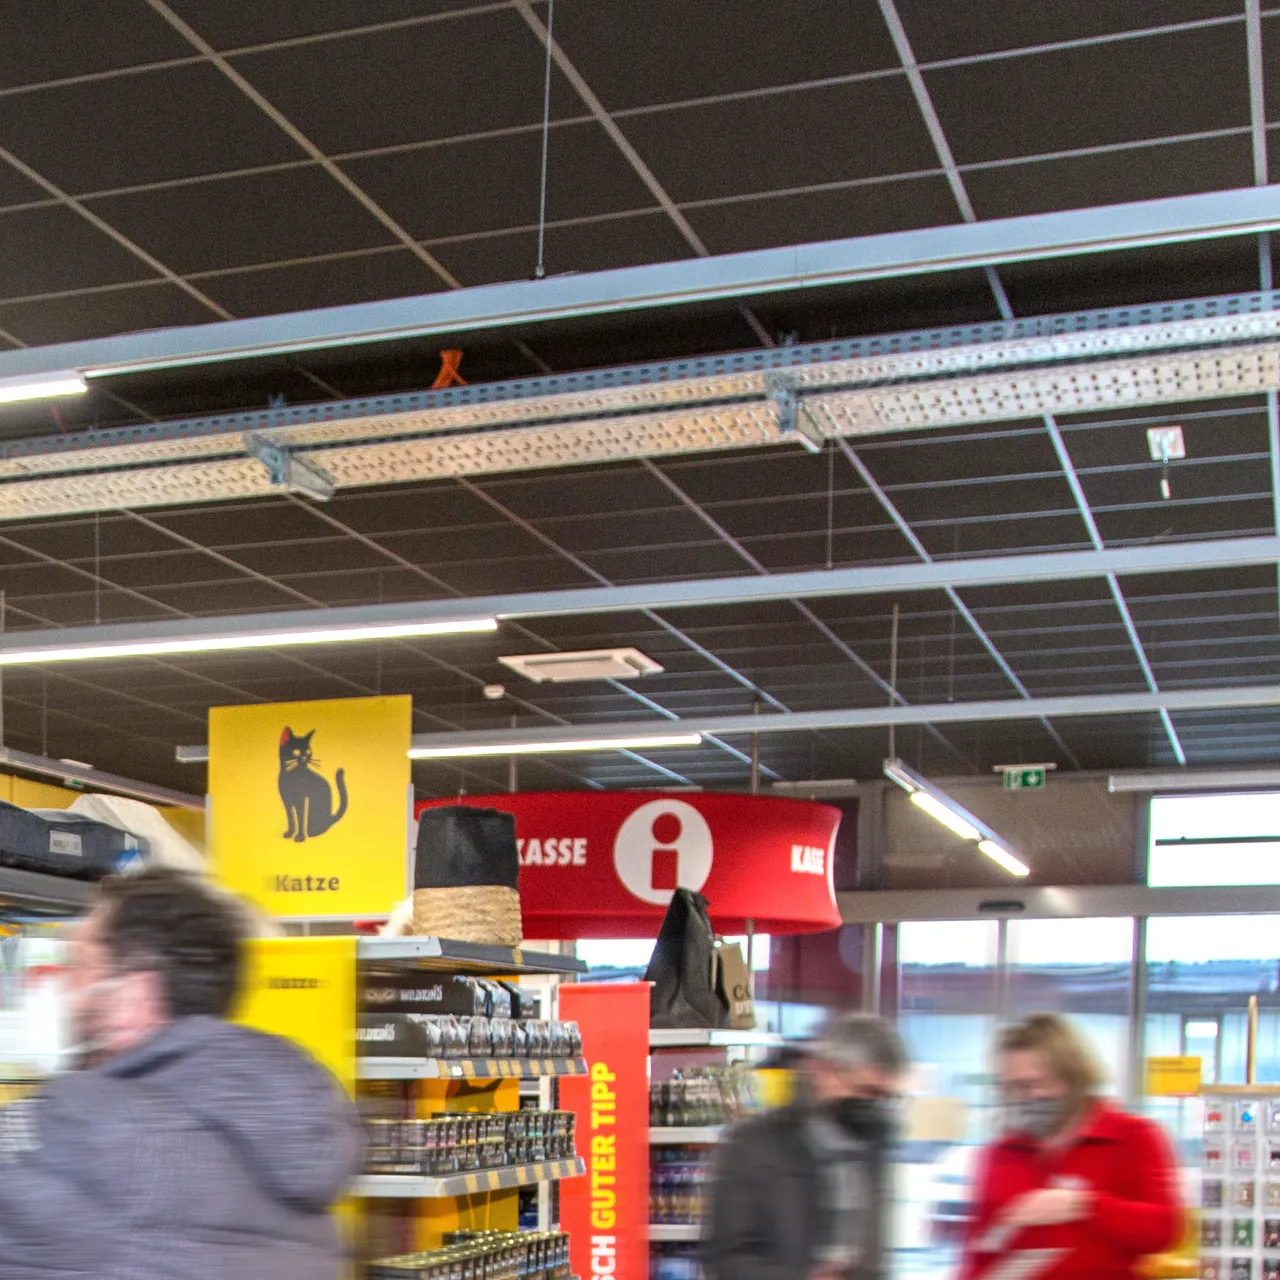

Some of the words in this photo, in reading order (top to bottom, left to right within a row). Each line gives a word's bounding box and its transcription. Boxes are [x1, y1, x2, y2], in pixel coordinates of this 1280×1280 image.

[274, 874, 340, 892] Katze
[591, 1062, 616, 1129] TIPP
[591, 1134, 616, 1229] GUTER
